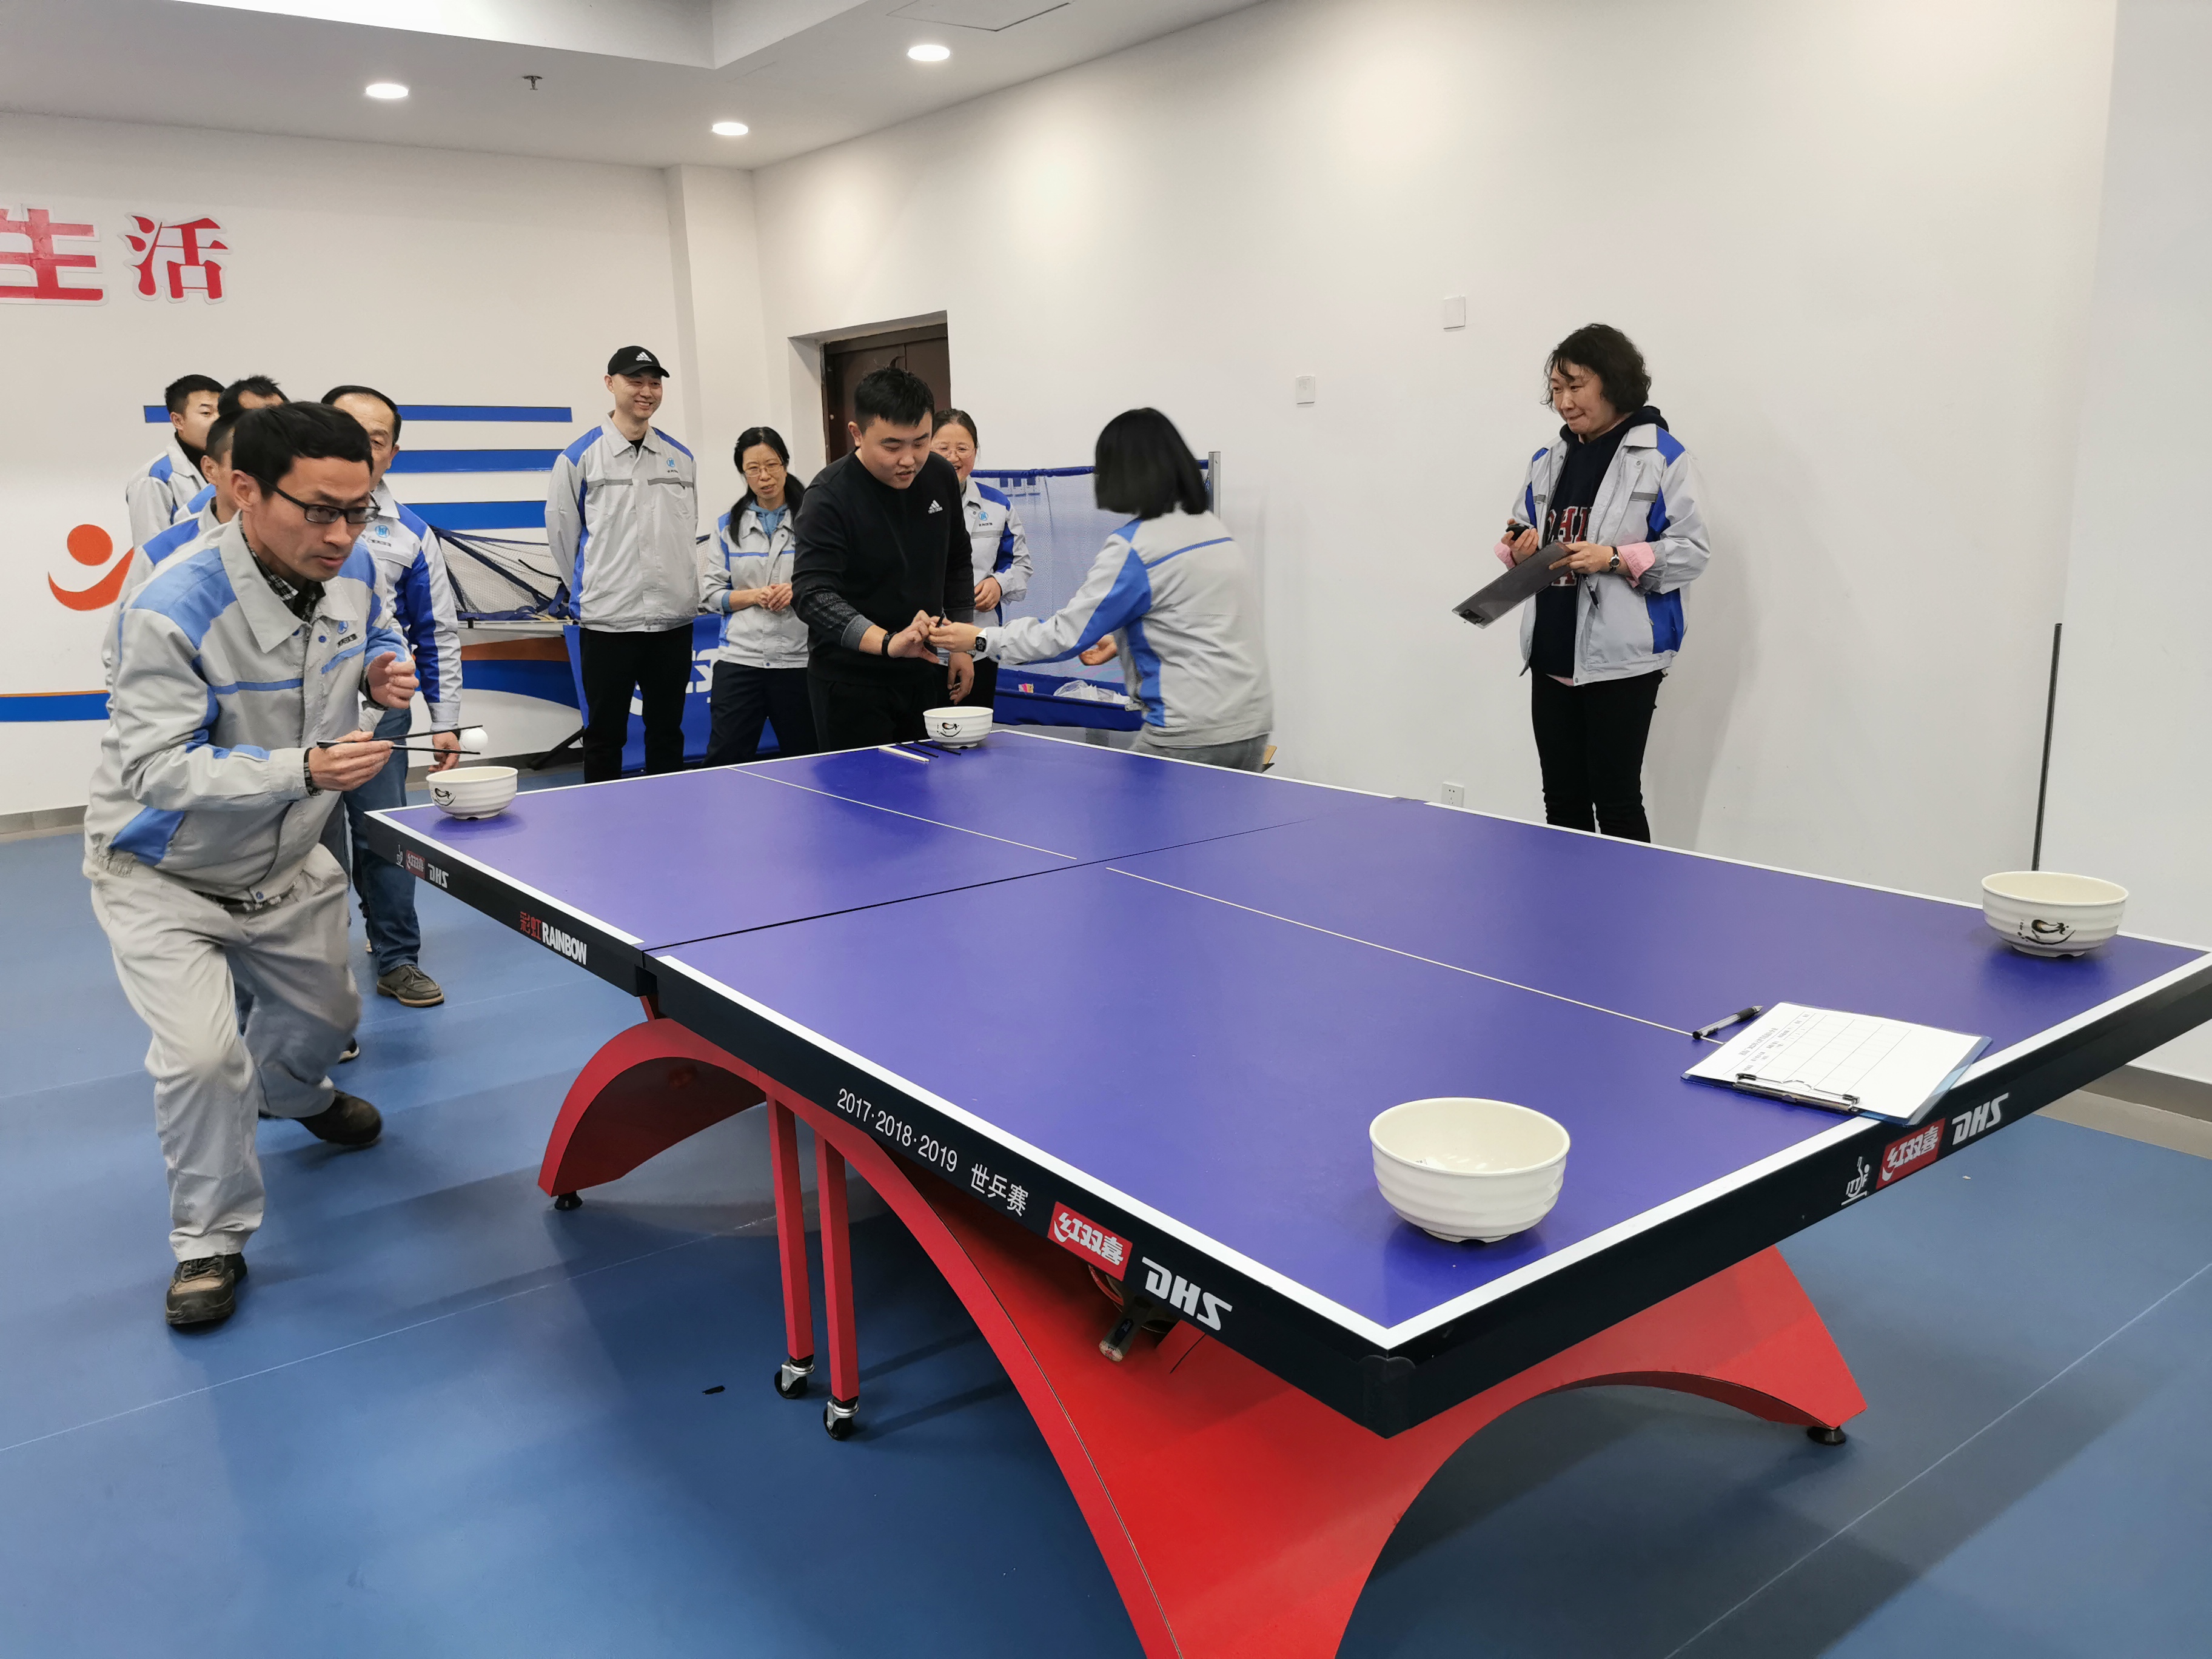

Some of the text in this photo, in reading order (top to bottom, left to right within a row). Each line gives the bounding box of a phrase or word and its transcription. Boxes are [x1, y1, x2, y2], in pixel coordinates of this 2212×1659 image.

[0, 208, 228, 300] 生活
[427, 863, 449, 889] DHS
[541, 921, 587, 965] RAINBOW
[1882, 1125, 1939, 1182] 红双喜
[1951, 1092, 2009, 1145] DHS
[971, 1163, 1028, 1216] 世乒赛
[1054, 1212, 1233, 1331] 红双喜 DHS
